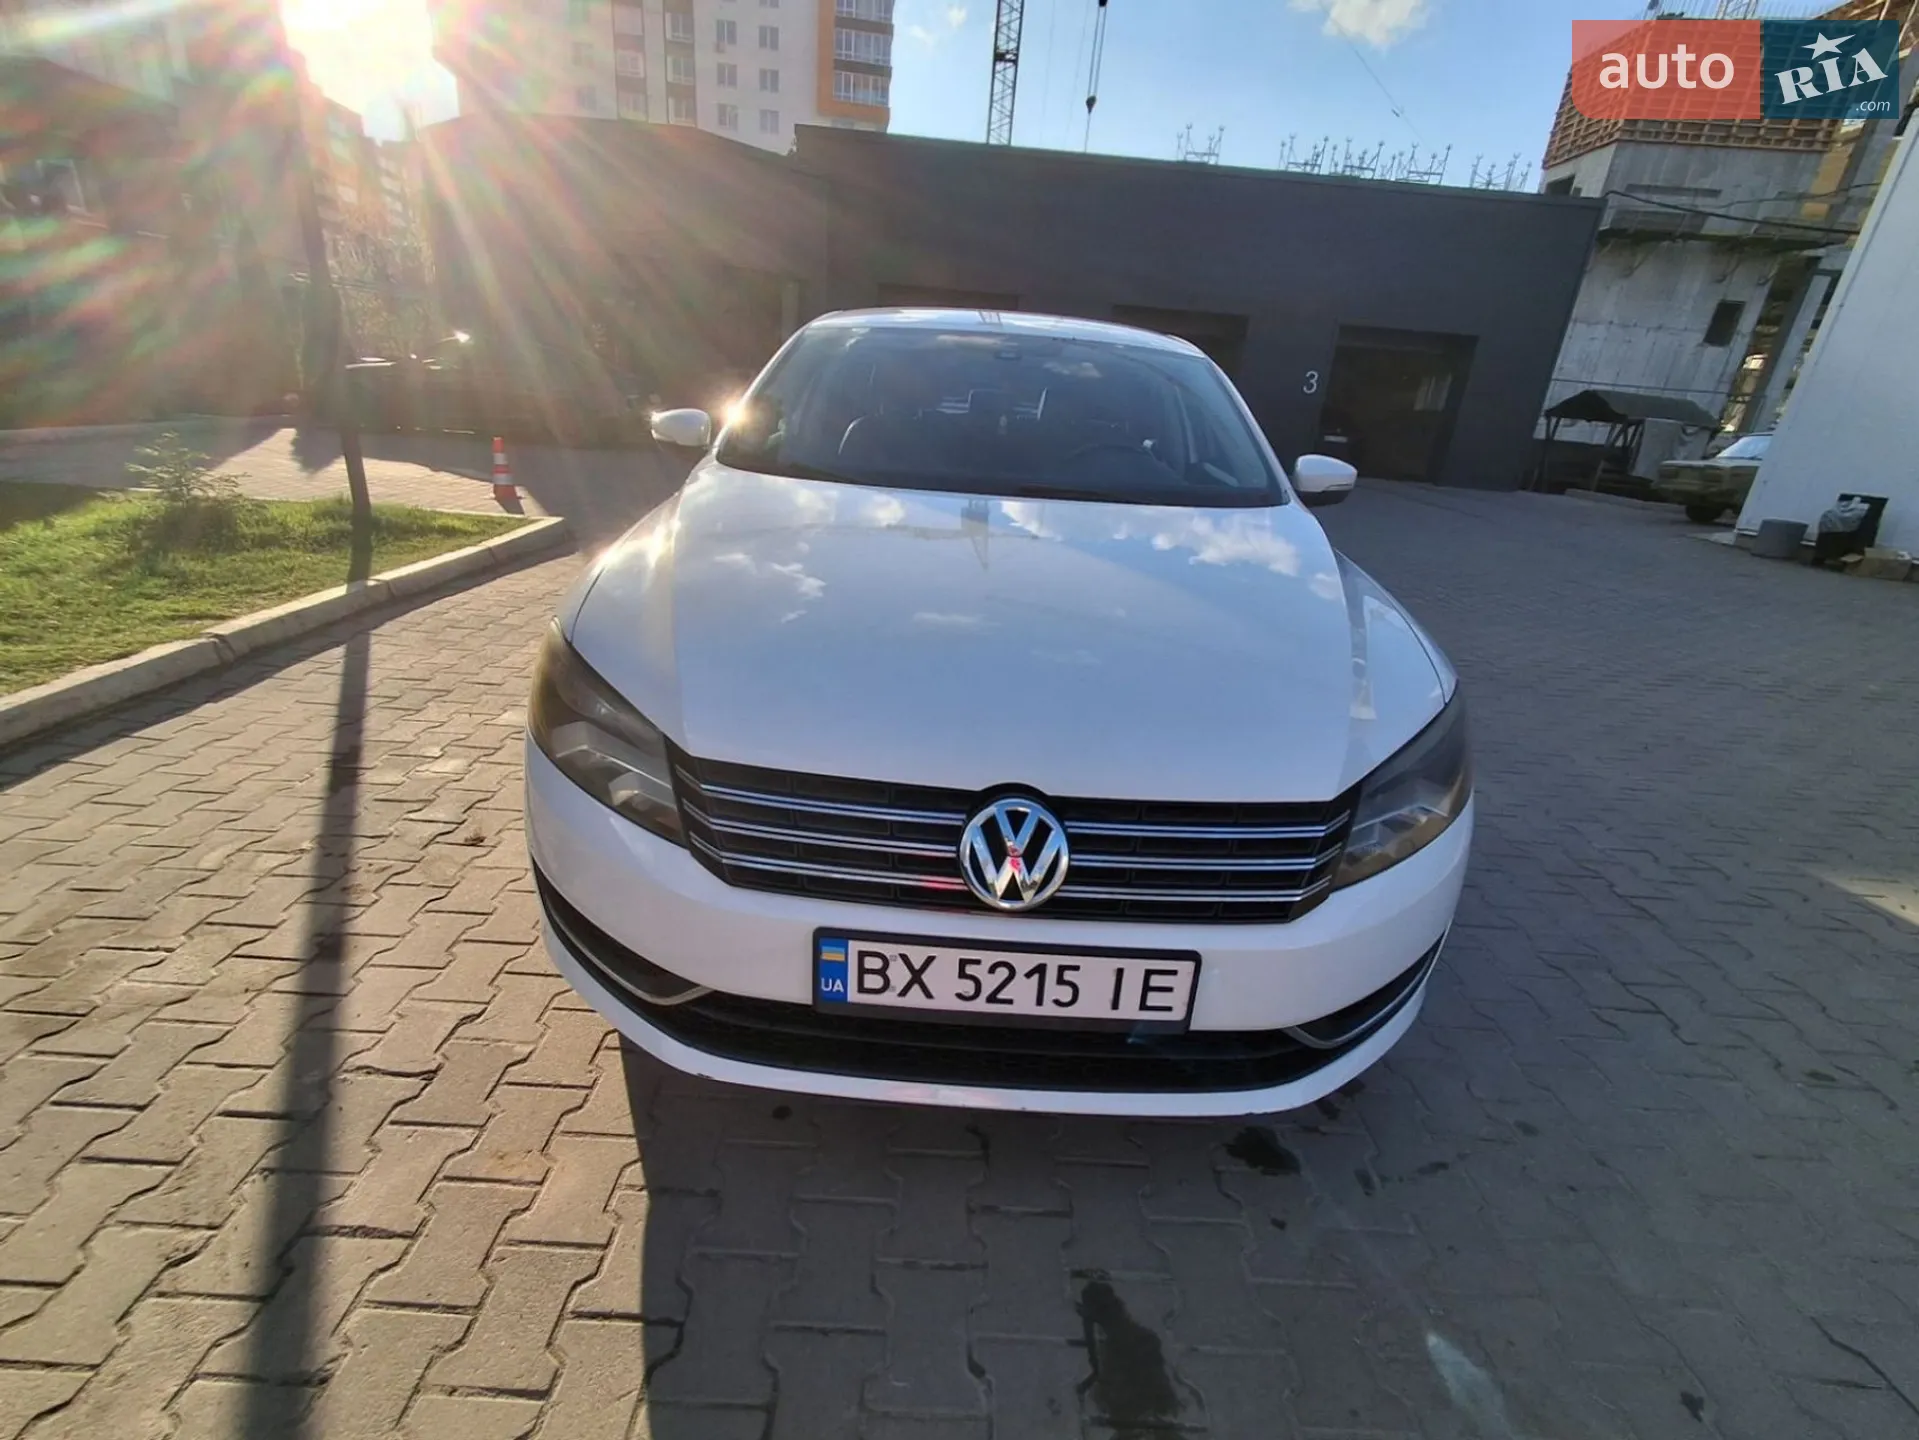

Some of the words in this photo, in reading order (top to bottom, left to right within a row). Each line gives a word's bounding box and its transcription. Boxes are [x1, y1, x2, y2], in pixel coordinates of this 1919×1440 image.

[1303, 370, 1319, 394] 3
[821, 977, 844, 994] UA
[856, 950, 937, 1000] BX
[955, 958, 1080, 1008] 5215
[1111, 967, 1179, 1012] IE
